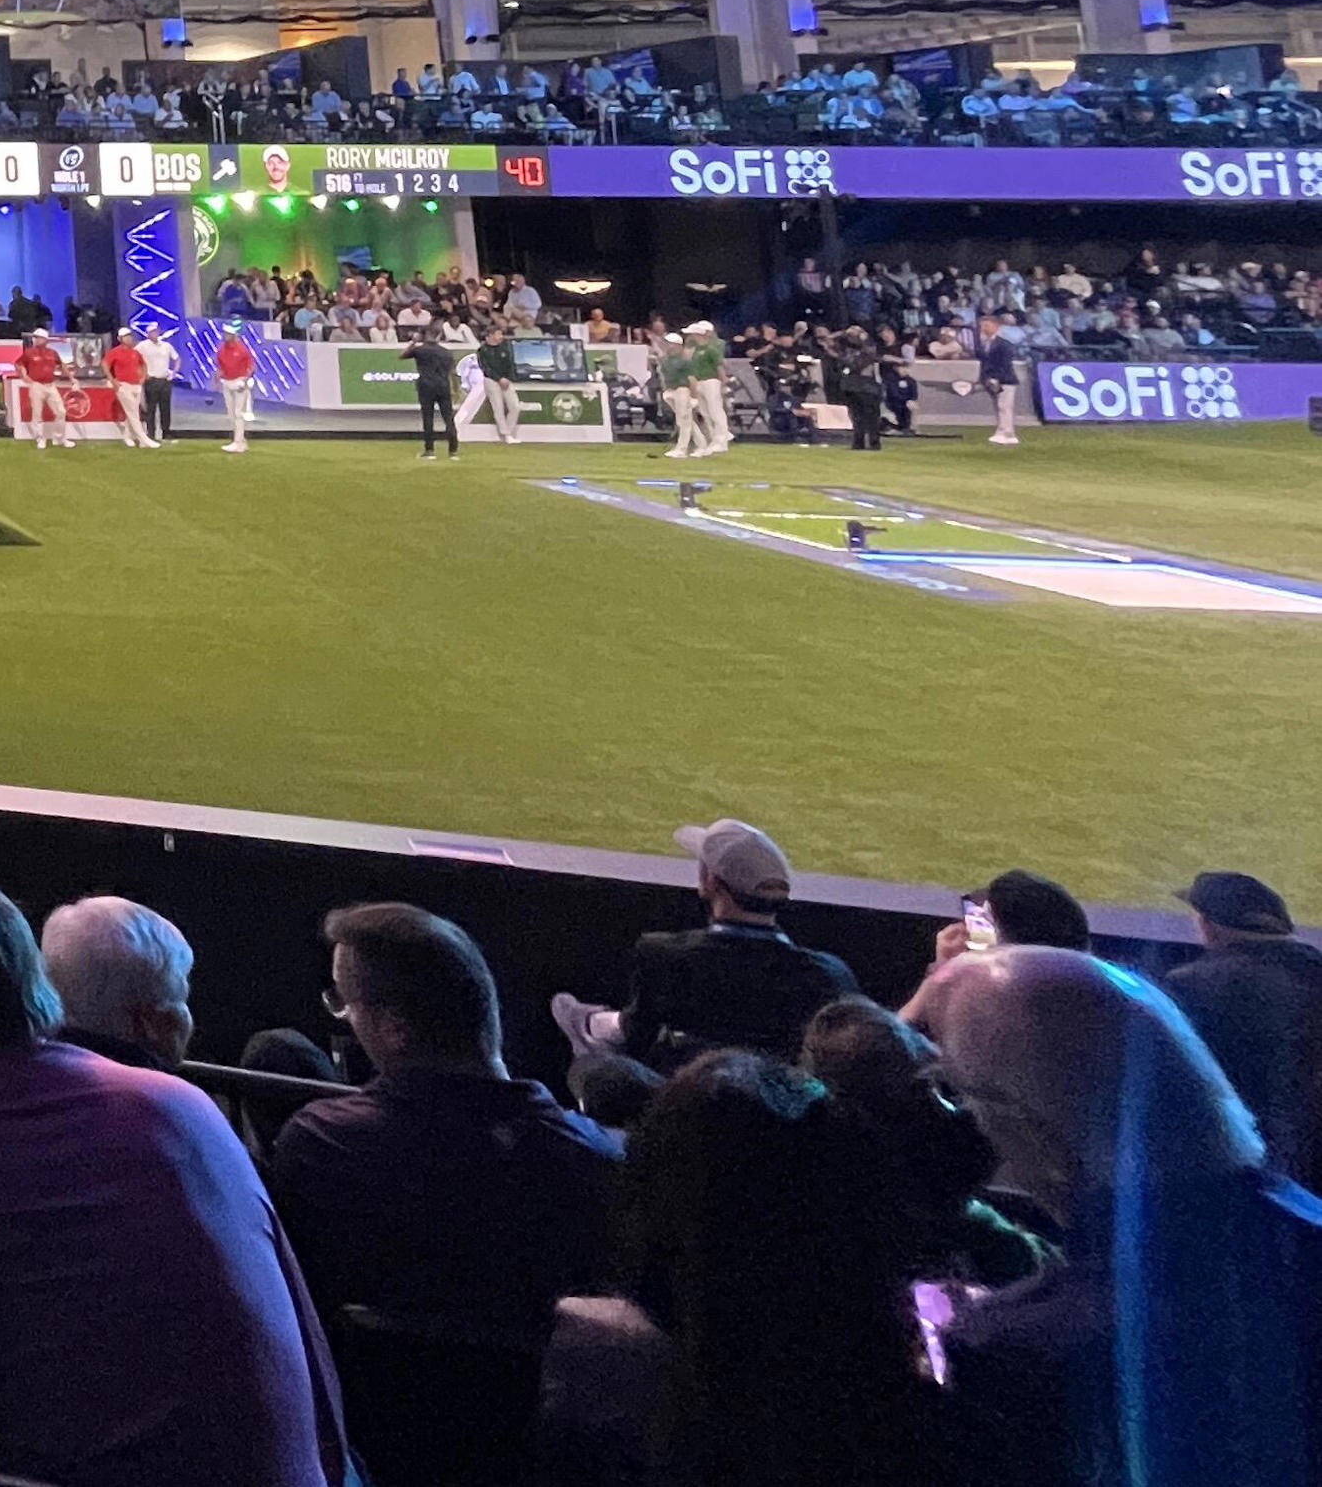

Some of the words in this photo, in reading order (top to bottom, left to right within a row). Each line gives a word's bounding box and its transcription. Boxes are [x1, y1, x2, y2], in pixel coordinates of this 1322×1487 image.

[5, 156, 19, 183] 0
[120, 156, 133, 183] 0
[154, 153, 202, 182] BOS
[326, 147, 371, 168] RORY
[374, 148, 450, 169] MCILROY
[505, 157, 545, 187] 40
[669, 149, 777, 194] SoFi
[395, 173, 404, 193] 1
[413, 174, 424, 193] 2
[430, 174, 442, 193] 3
[448, 174, 459, 193] 4
[1181, 151, 1291, 196] SoFi
[1051, 365, 1175, 417] SoFi
